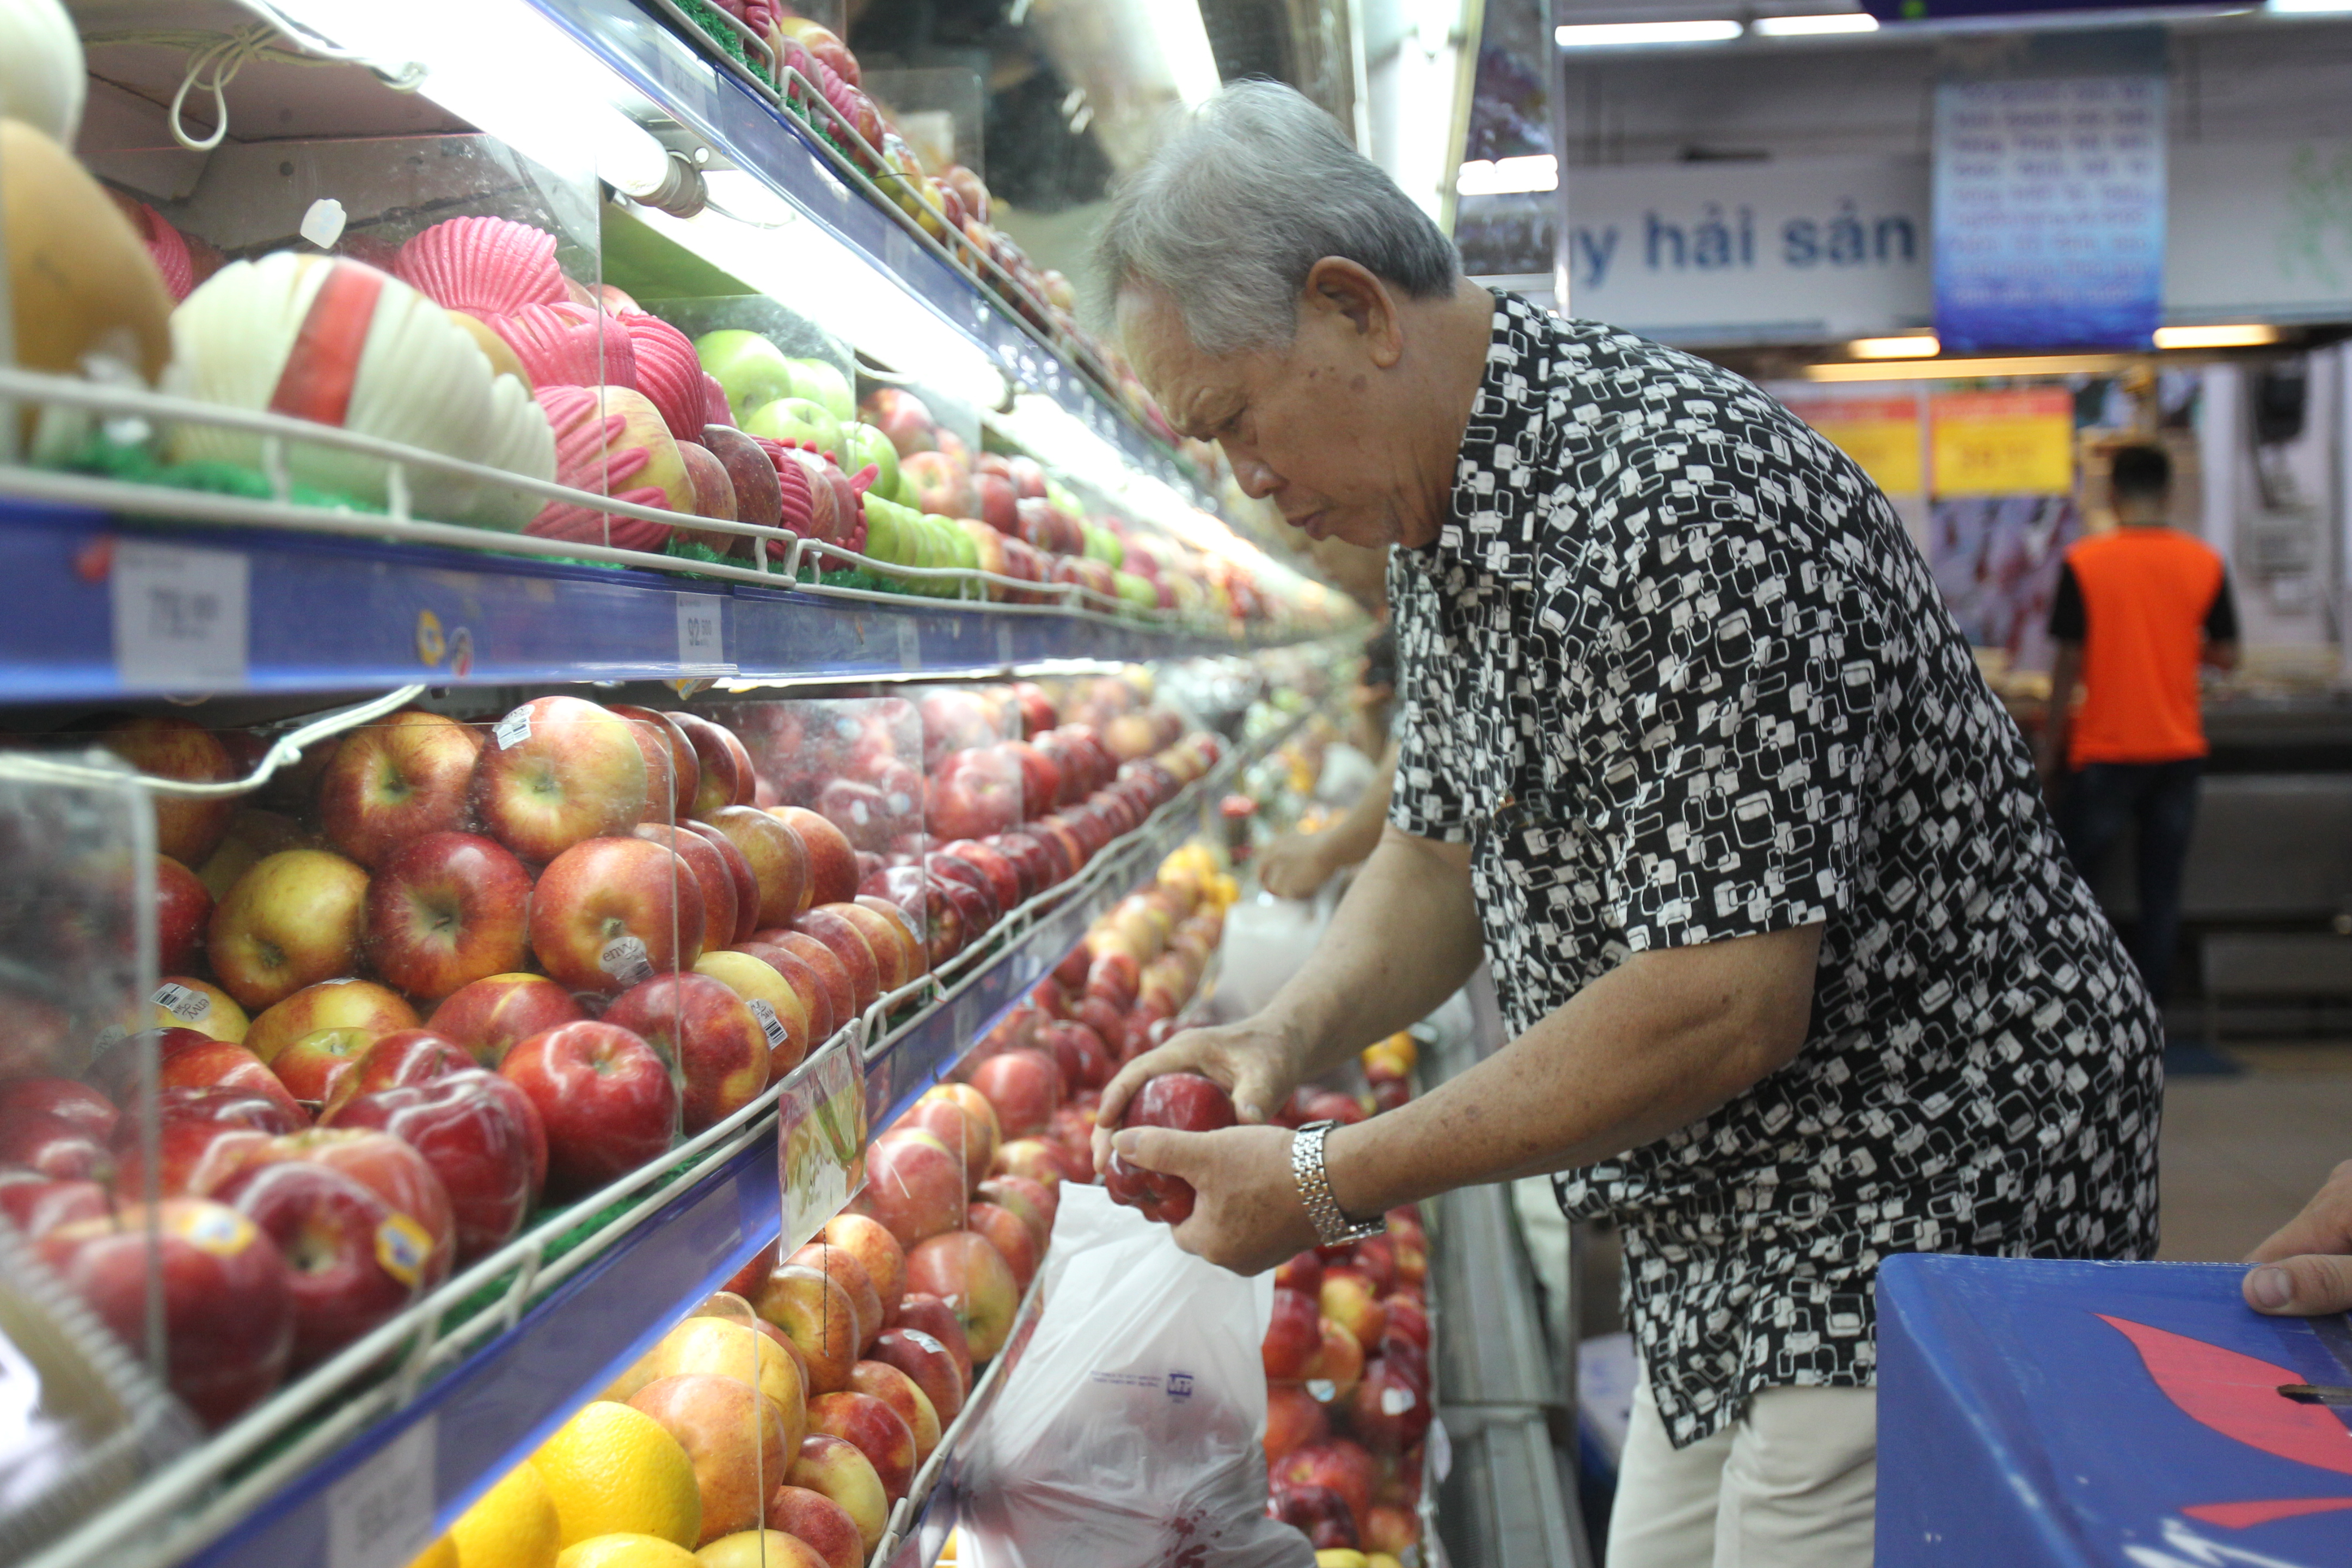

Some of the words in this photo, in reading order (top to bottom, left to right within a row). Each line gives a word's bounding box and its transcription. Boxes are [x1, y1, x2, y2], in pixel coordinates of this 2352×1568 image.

[1644, 200, 1754, 267] hải
[1782, 197, 1915, 267] sản
[603, 940, 638, 962] envy
[182, 998, 210, 1020] envy
